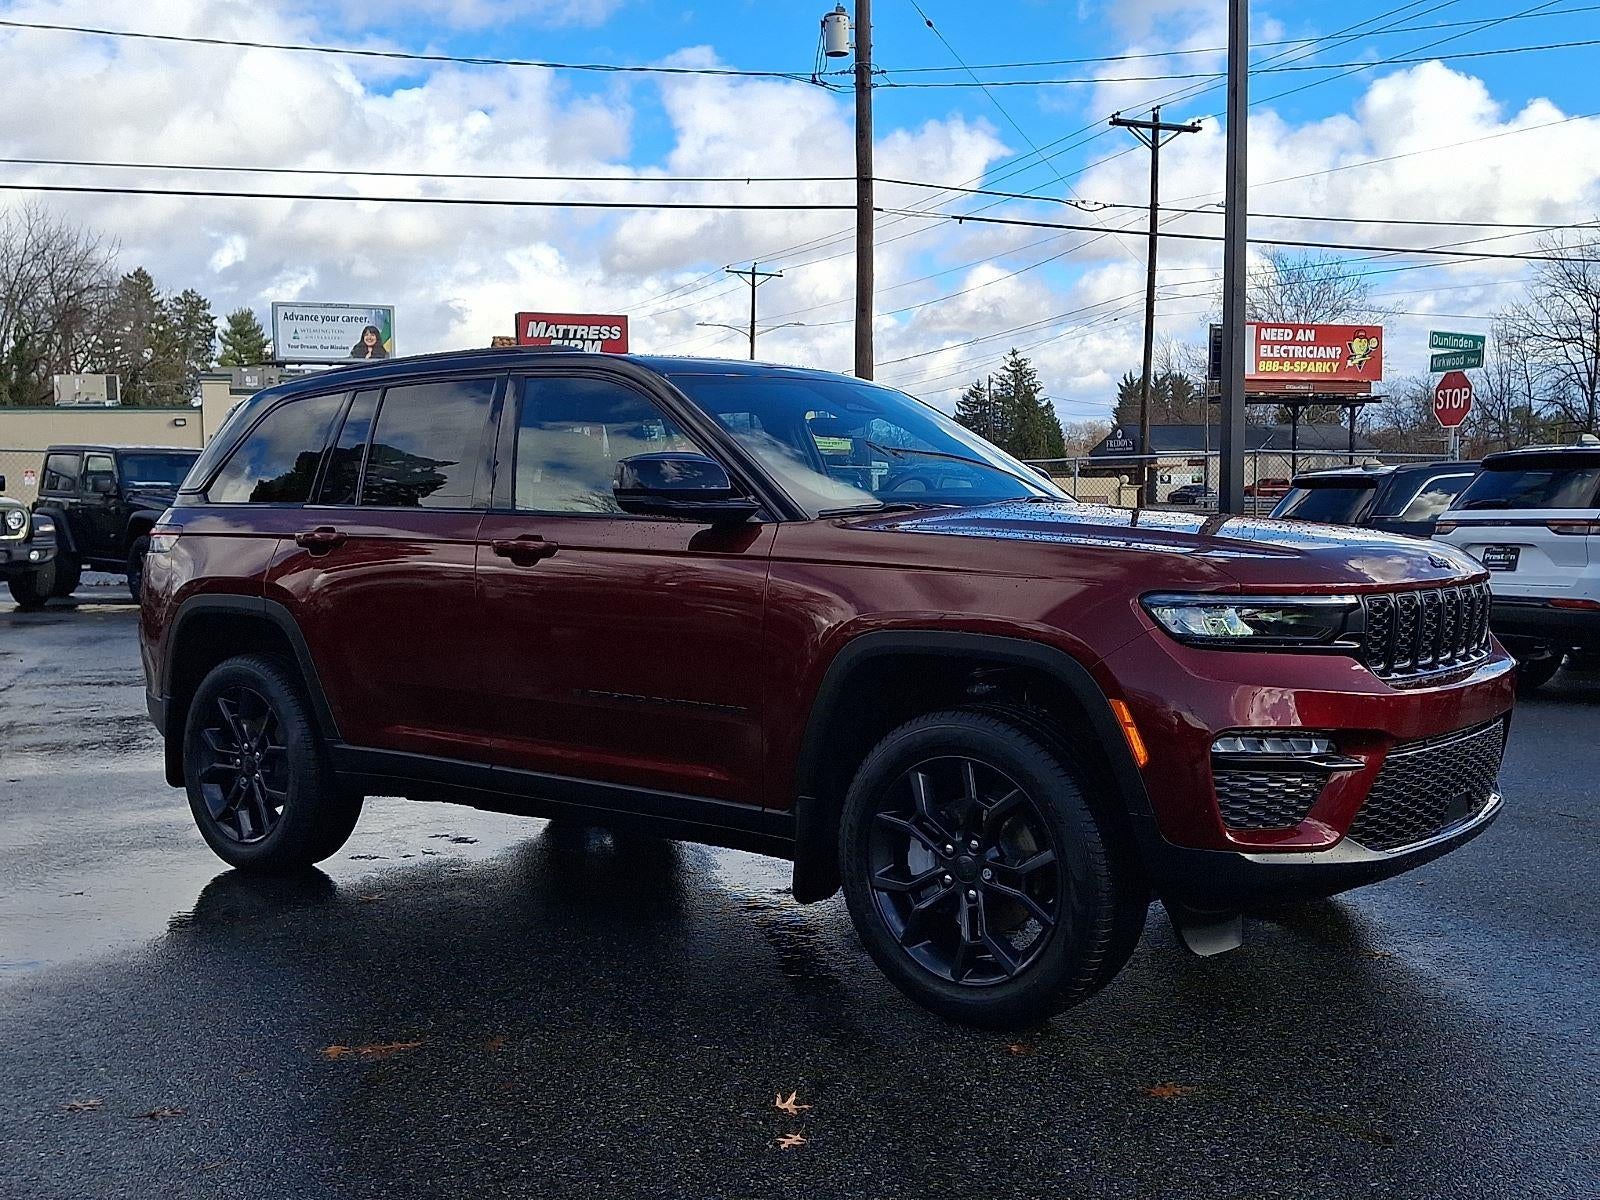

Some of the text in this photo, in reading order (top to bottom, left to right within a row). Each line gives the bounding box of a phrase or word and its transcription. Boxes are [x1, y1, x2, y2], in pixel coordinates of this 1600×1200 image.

[284, 312, 370, 324] Advance your career.
[1260, 328, 1315, 341] NEED AN
[1432, 335, 1473, 348] Dunlinden
[1260, 345, 1340, 359] ELECTRICIAN?
[1259, 361, 1339, 372] 888-8-SPARKY
[1432, 356, 1478, 368] Kirkwood Hwy
[1436, 388, 1470, 410] STOP
